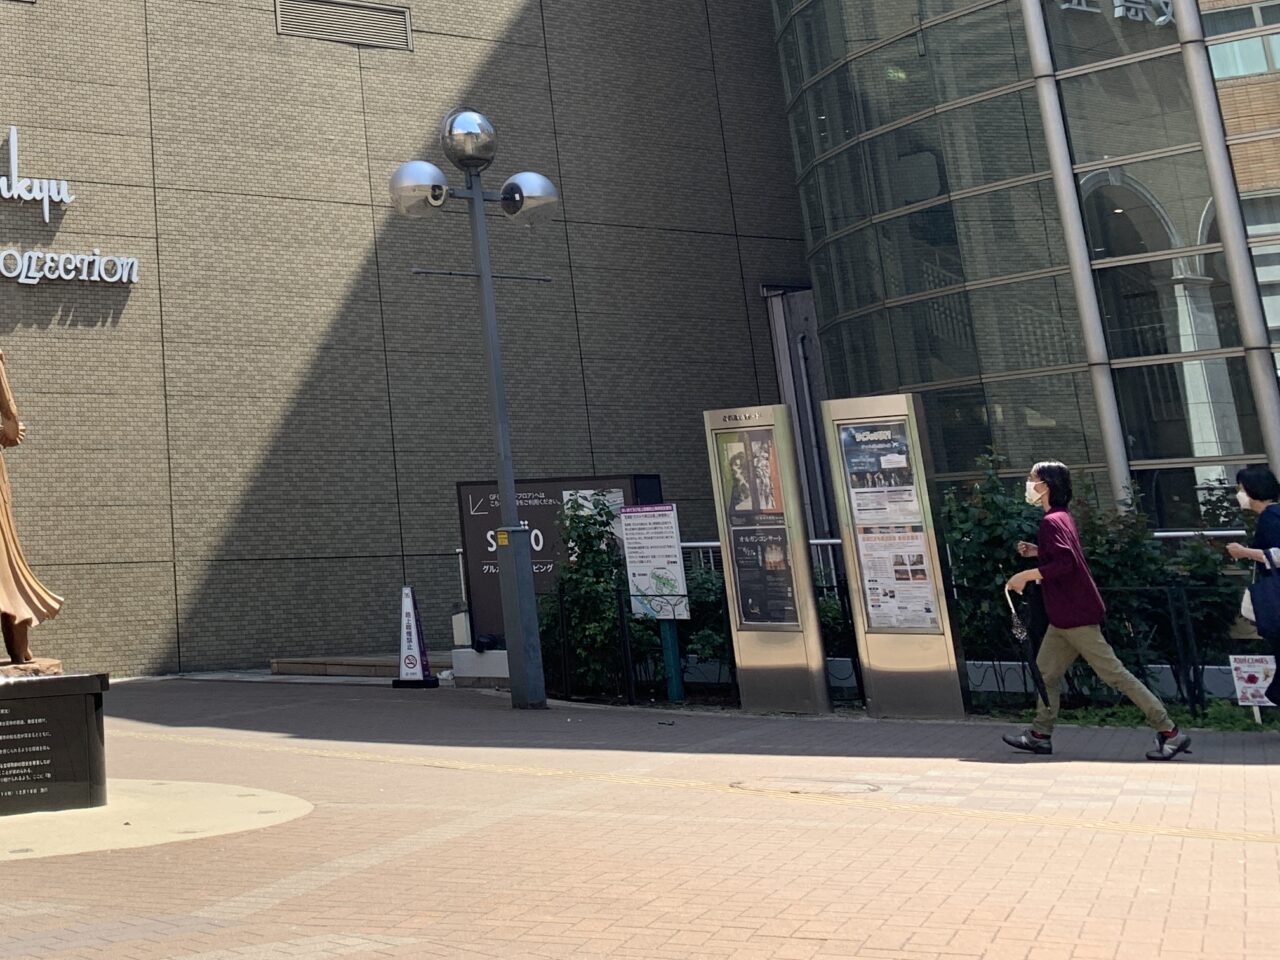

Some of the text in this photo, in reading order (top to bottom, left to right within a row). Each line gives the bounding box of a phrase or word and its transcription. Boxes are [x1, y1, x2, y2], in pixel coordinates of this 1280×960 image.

[739, 535, 783, 543] オルガンコンサート
